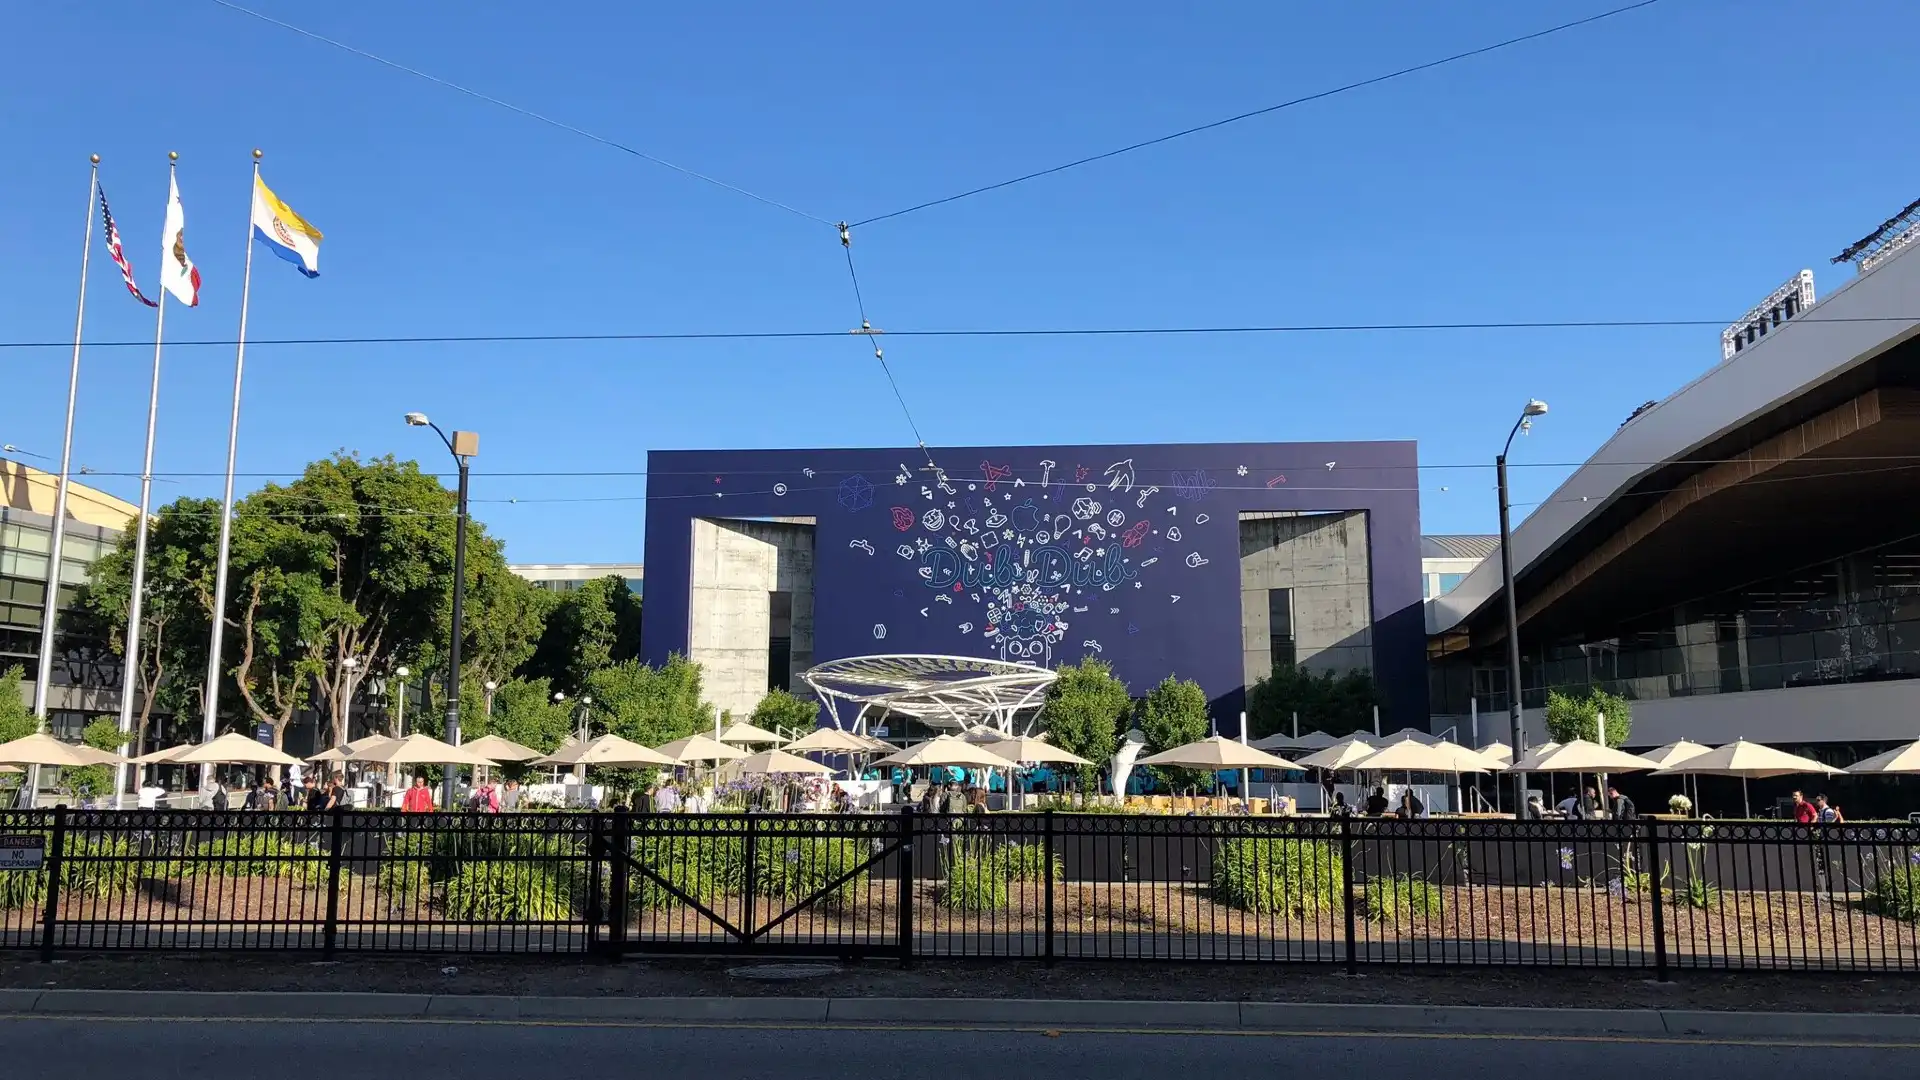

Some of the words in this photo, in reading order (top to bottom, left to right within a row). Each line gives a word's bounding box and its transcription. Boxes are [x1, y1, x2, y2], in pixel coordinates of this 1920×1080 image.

[1031, 543, 1138, 587] Dub
[3, 837, 36, 846] DANGER
[11, 850, 24, 860] NO
